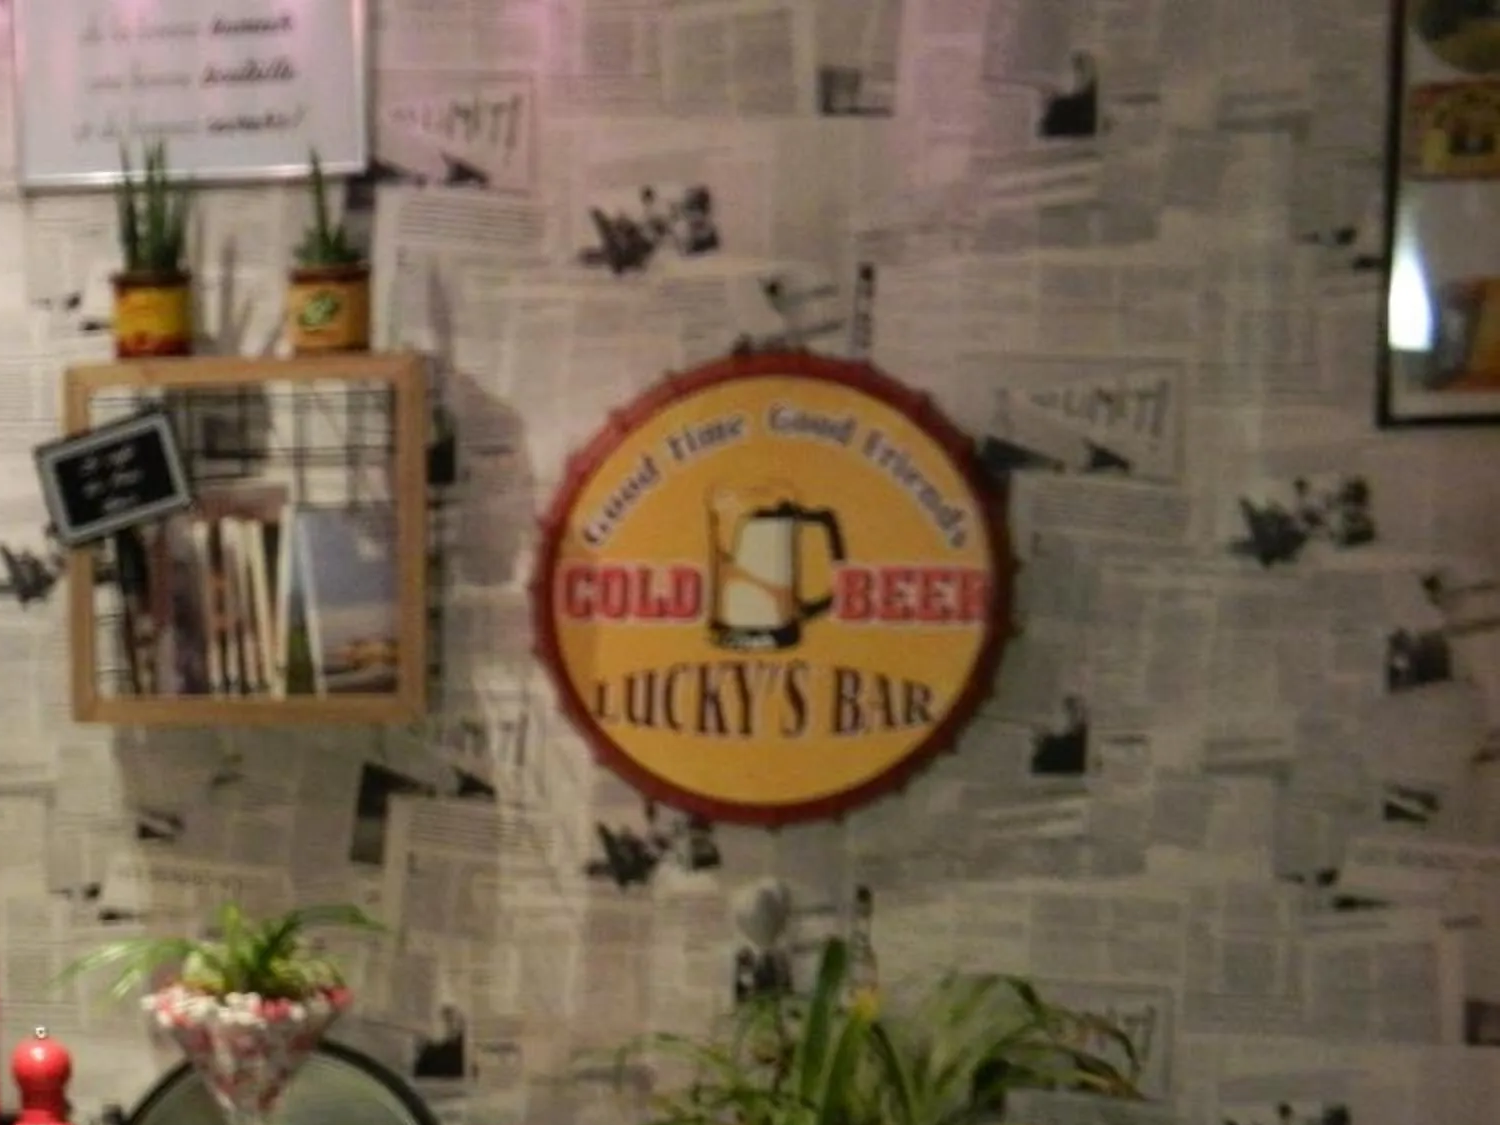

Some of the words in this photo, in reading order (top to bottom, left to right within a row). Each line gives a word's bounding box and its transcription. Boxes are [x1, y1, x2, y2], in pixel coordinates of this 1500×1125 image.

[563, 564, 704, 621] COLD
[594, 660, 808, 738] LUCKY'S
[831, 667, 936, 737] BAR
